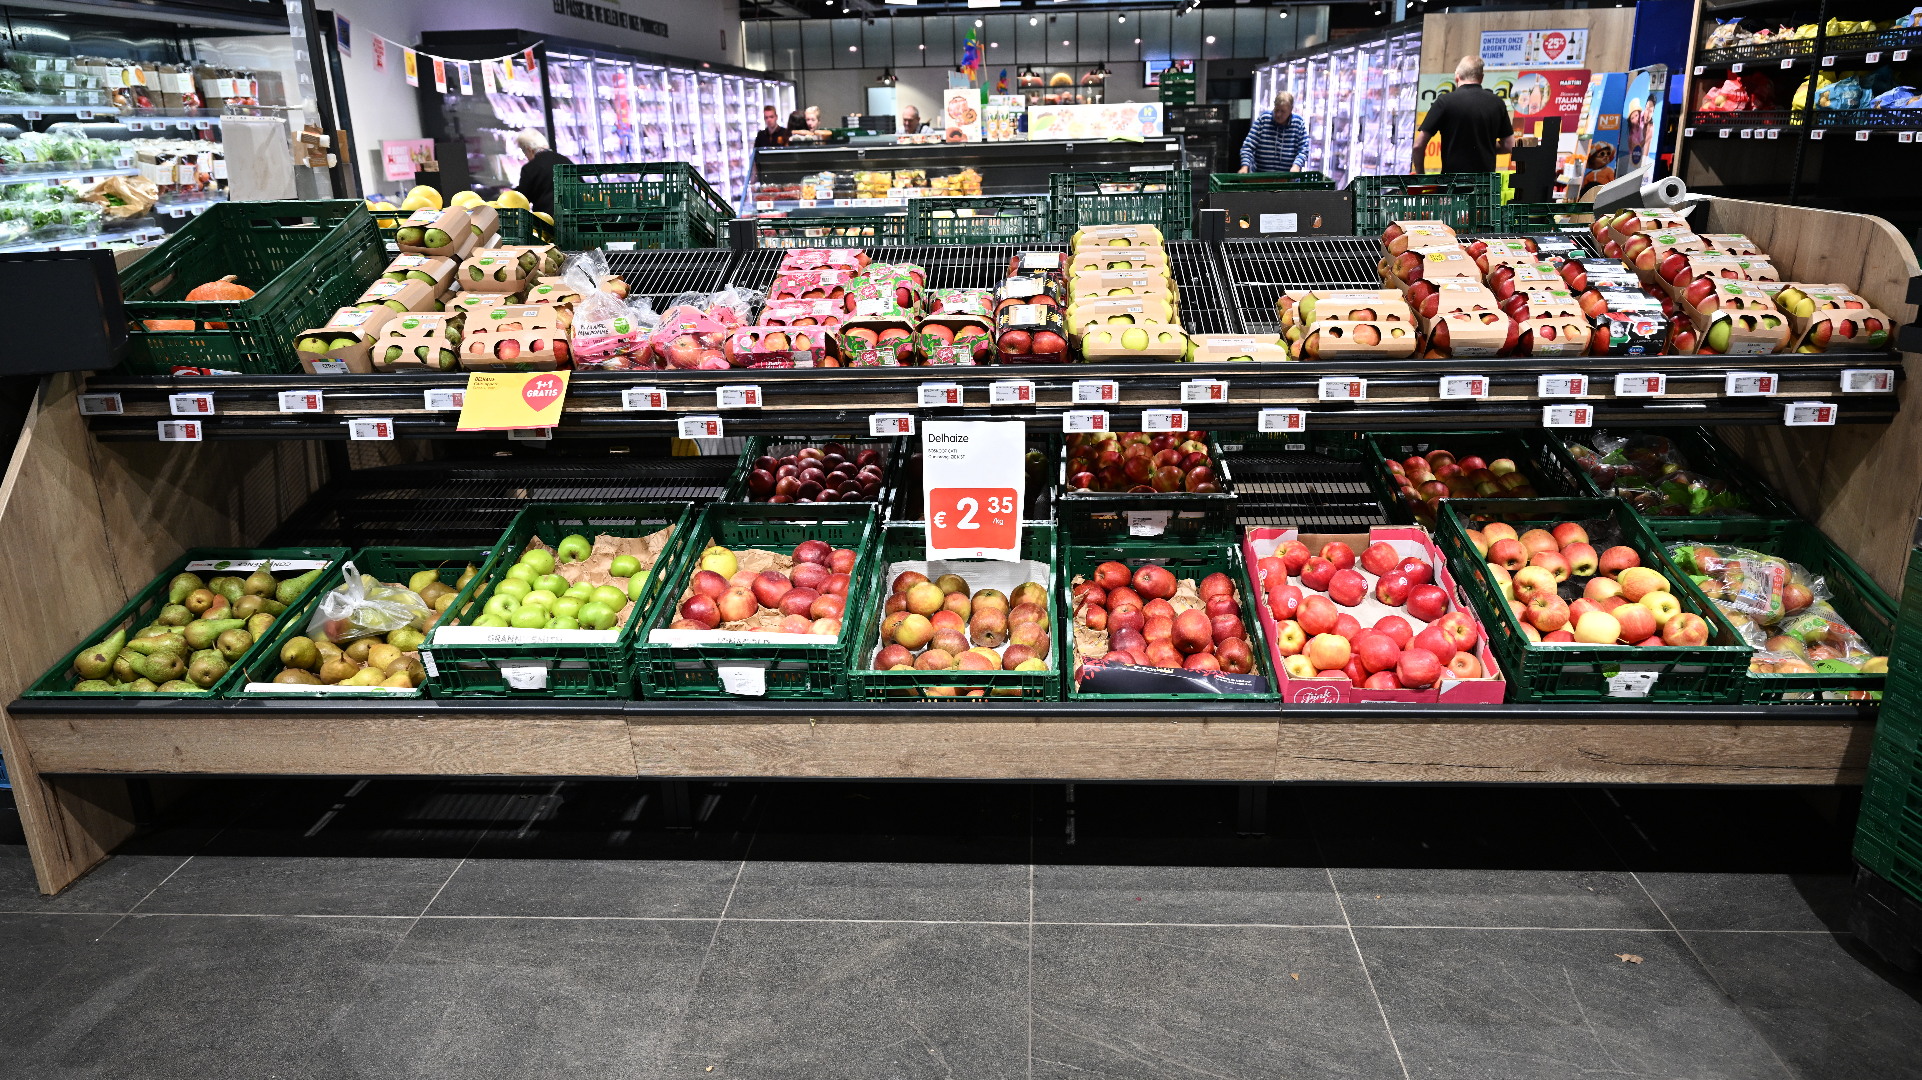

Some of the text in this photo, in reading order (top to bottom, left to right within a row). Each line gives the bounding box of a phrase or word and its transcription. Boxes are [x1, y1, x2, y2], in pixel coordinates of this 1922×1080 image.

[1544, 38, 1564, 49] -25%
[536, 380, 554, 389] 1+1
[526, 389, 558, 398] GRATIS
[928, 433, 969, 443] Delhaize
[933, 496, 1013, 530] € 2 35
[992, 518, 1004, 526] /kg
